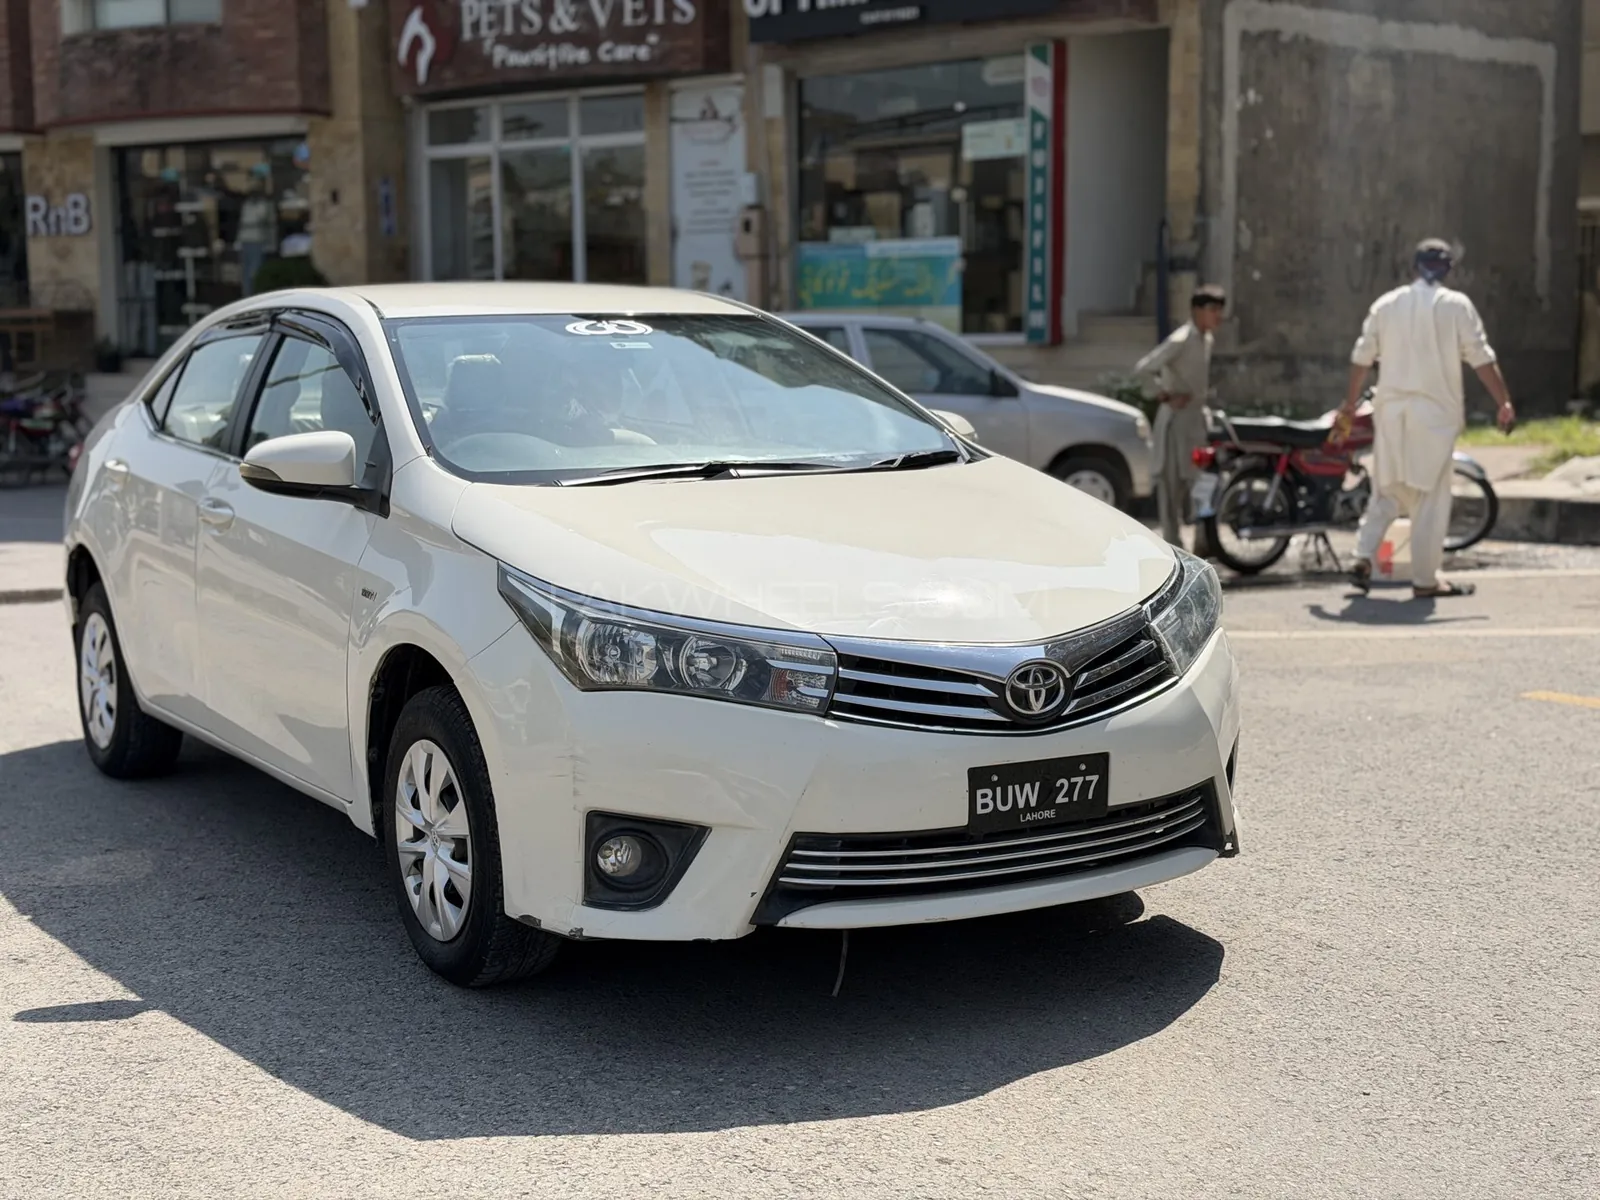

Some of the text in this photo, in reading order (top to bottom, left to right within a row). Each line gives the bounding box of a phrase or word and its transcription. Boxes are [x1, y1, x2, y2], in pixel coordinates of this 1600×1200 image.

[461, 0, 542, 41] PETS
[549, 0, 580, 34] &
[25, 193, 91, 236] RnB
[976, 775, 1100, 814] BUW 277
[1020, 809, 1056, 822] LAHORE
